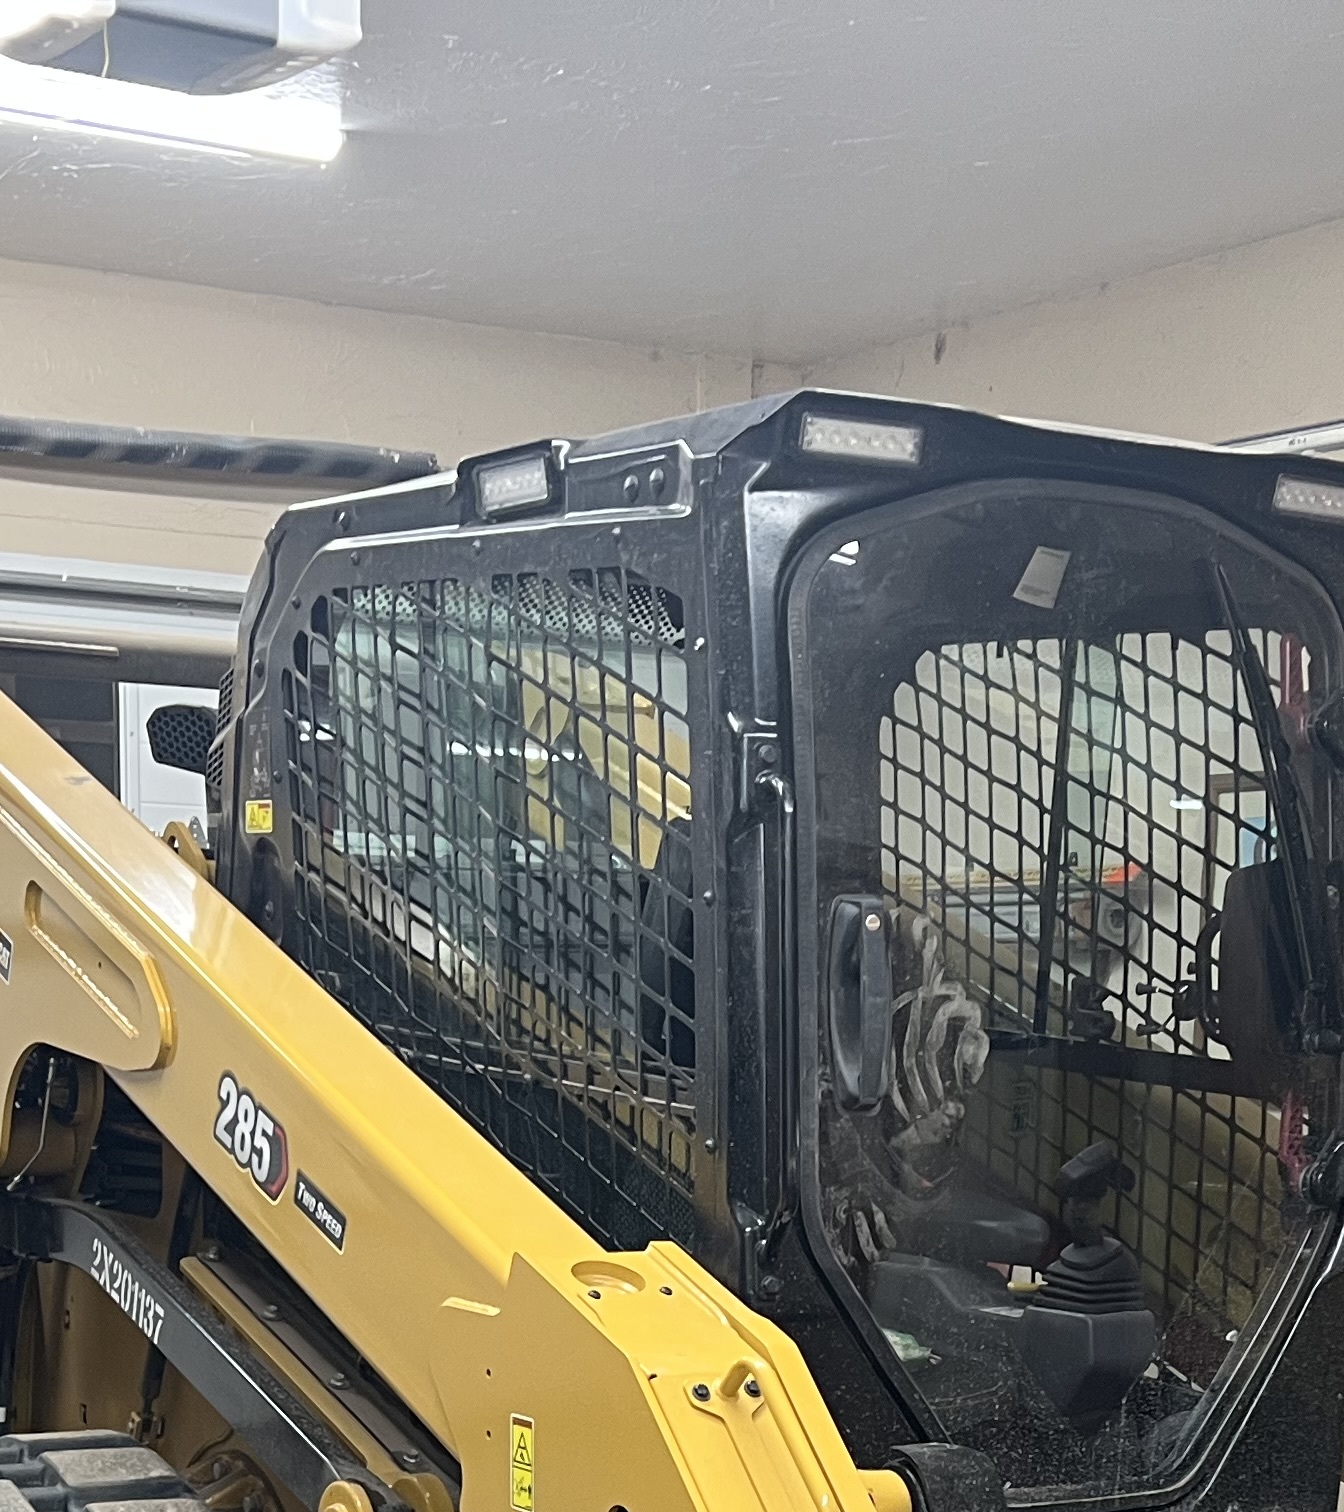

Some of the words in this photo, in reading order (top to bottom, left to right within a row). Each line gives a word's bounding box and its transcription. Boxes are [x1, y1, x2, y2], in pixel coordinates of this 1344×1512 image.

[214, 1076, 275, 1183] 285
[297, 1181, 317, 1213] TWO
[315, 1201, 342, 1239] SPEED
[90, 1238, 165, 1345] 2X201137
